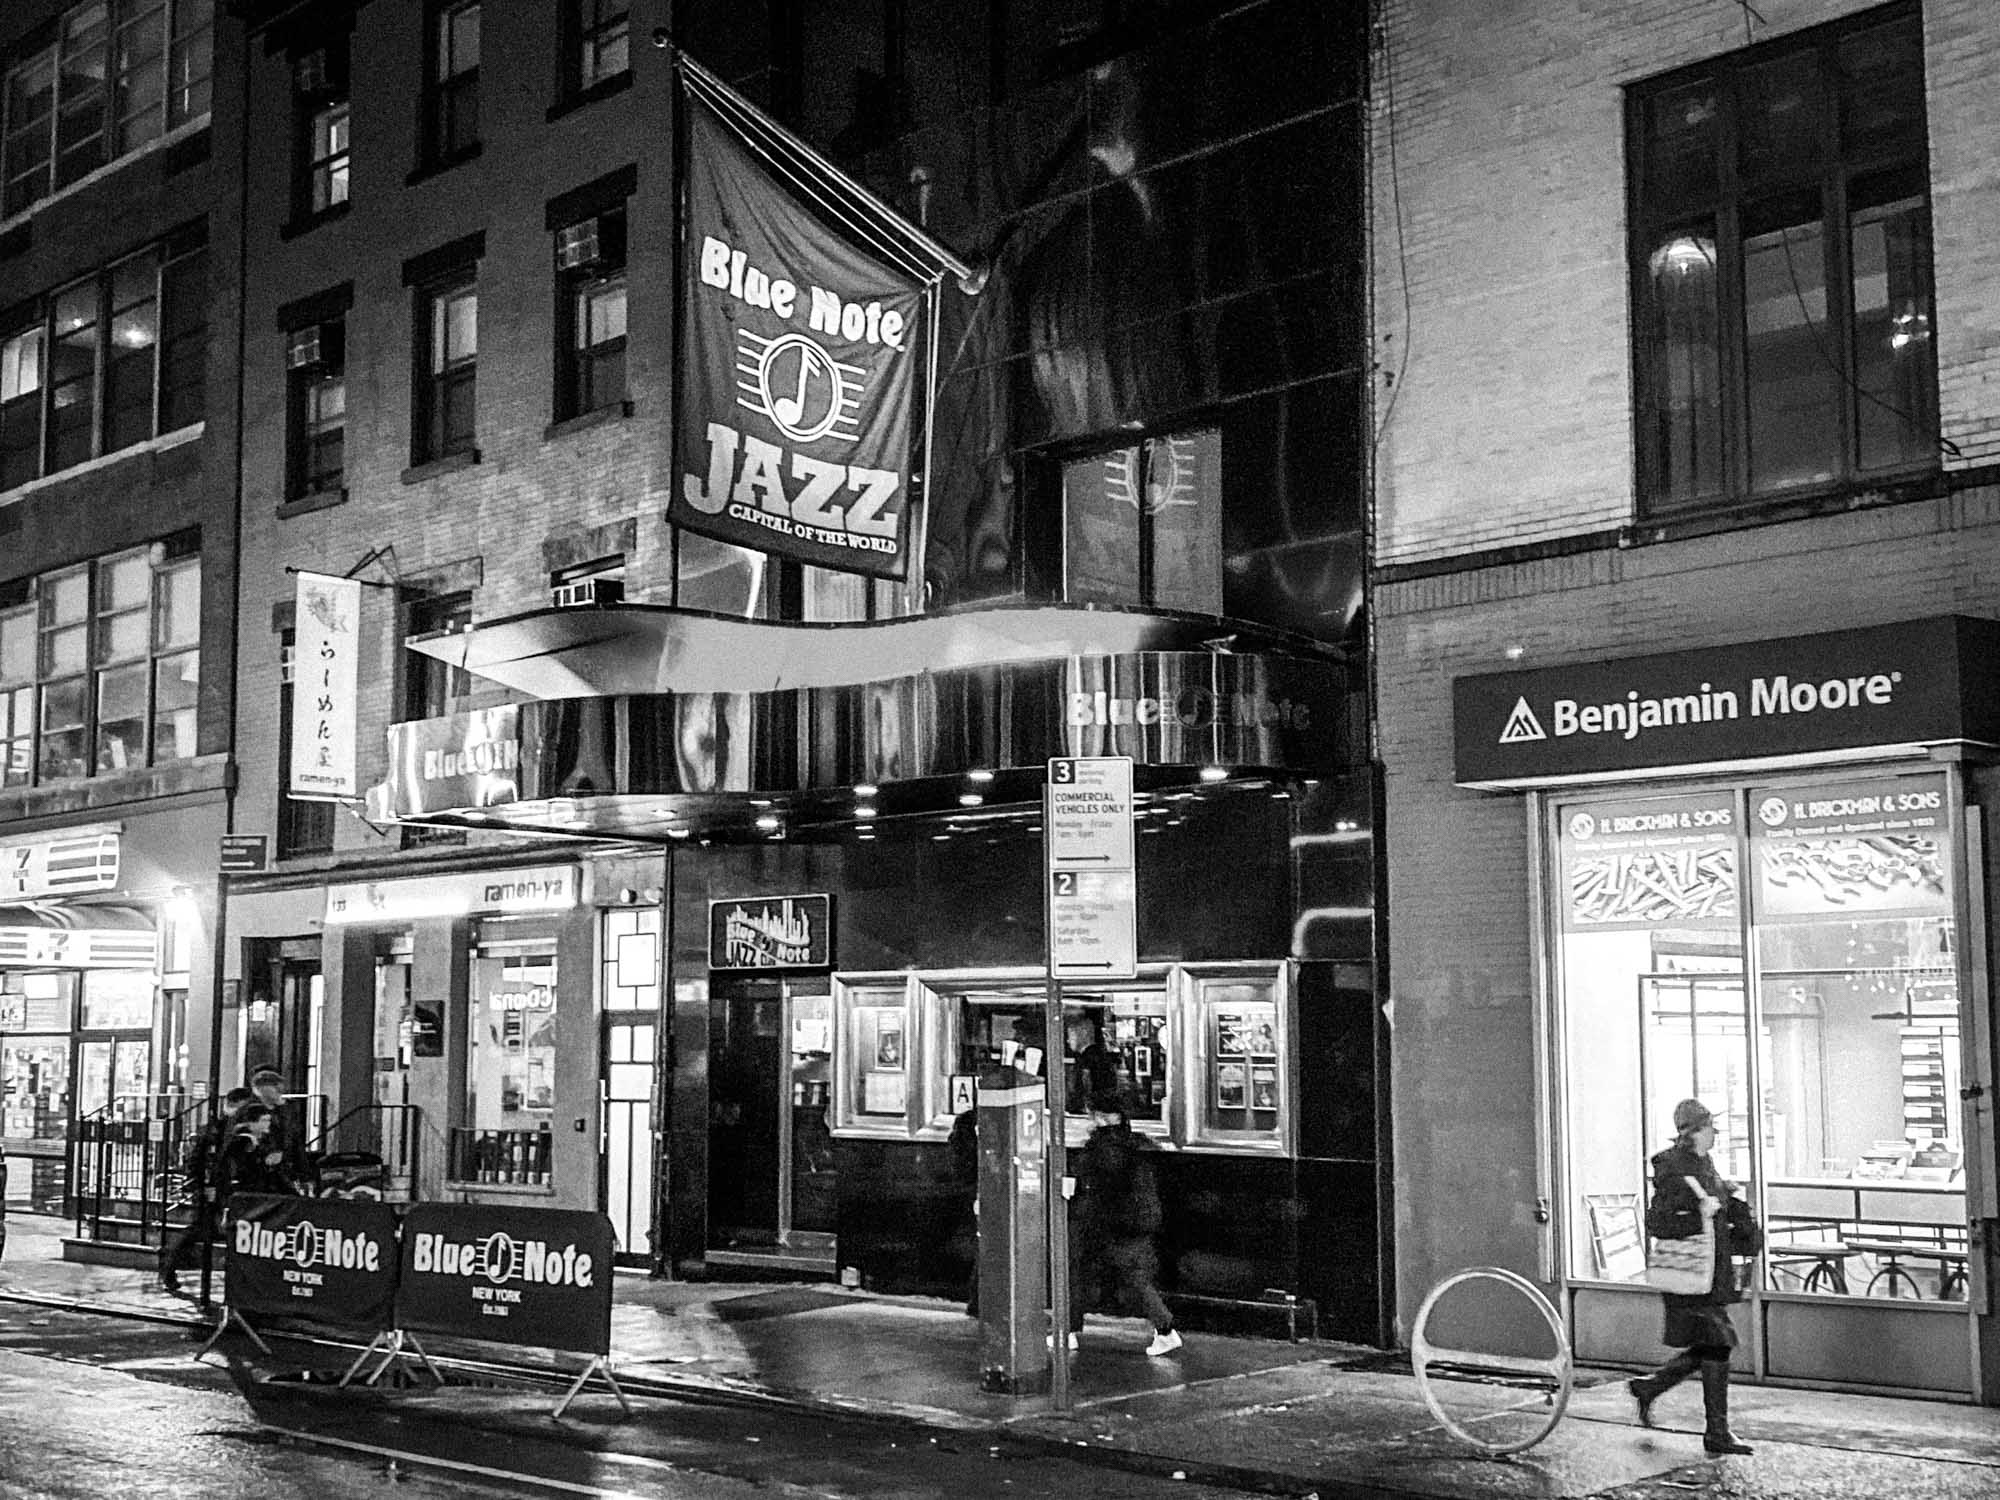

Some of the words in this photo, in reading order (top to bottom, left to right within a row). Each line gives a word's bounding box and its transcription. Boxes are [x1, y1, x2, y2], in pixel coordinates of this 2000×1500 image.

[700, 236, 796, 319] Blue
[808, 286, 904, 352] Note
[683, 422, 900, 539] JAZZ
[728, 503, 793, 535] CAPITAL
[794, 523, 815, 541] OF
[815, 529, 848, 546] THE
[848, 534, 897, 554] WORLD
[1066, 691, 1160, 725] Blue
[1554, 682, 1739, 740] Benjamin
[1056, 761, 1071, 782] 3
[1055, 792, 1115, 802] COMMERCIAL
[1883, 796, 1895, 811] &
[1898, 791, 1941, 811] SONS
[1055, 804, 1099, 815] VEHICLES
[1101, 804, 1125, 814] ONLY
[1680, 812, 1692, 828] &
[1693, 808, 1732, 826] SONS
[485, 880, 562, 902] ramen-ya
[1058, 873, 1072, 895] 2
[726, 922, 756, 942] Blue
[777, 943, 810, 963] Note
[957, 1082, 969, 1103] A
[1023, 1109, 1037, 1137] P
[236, 1220, 287, 1260] Blue
[324, 1229, 380, 1272] Note
[414, 1233, 476, 1276] Blue
[523, 1241, 593, 1287] Note
[472, 1286, 494, 1300] NEW
[495, 1288, 521, 1303] YORK
